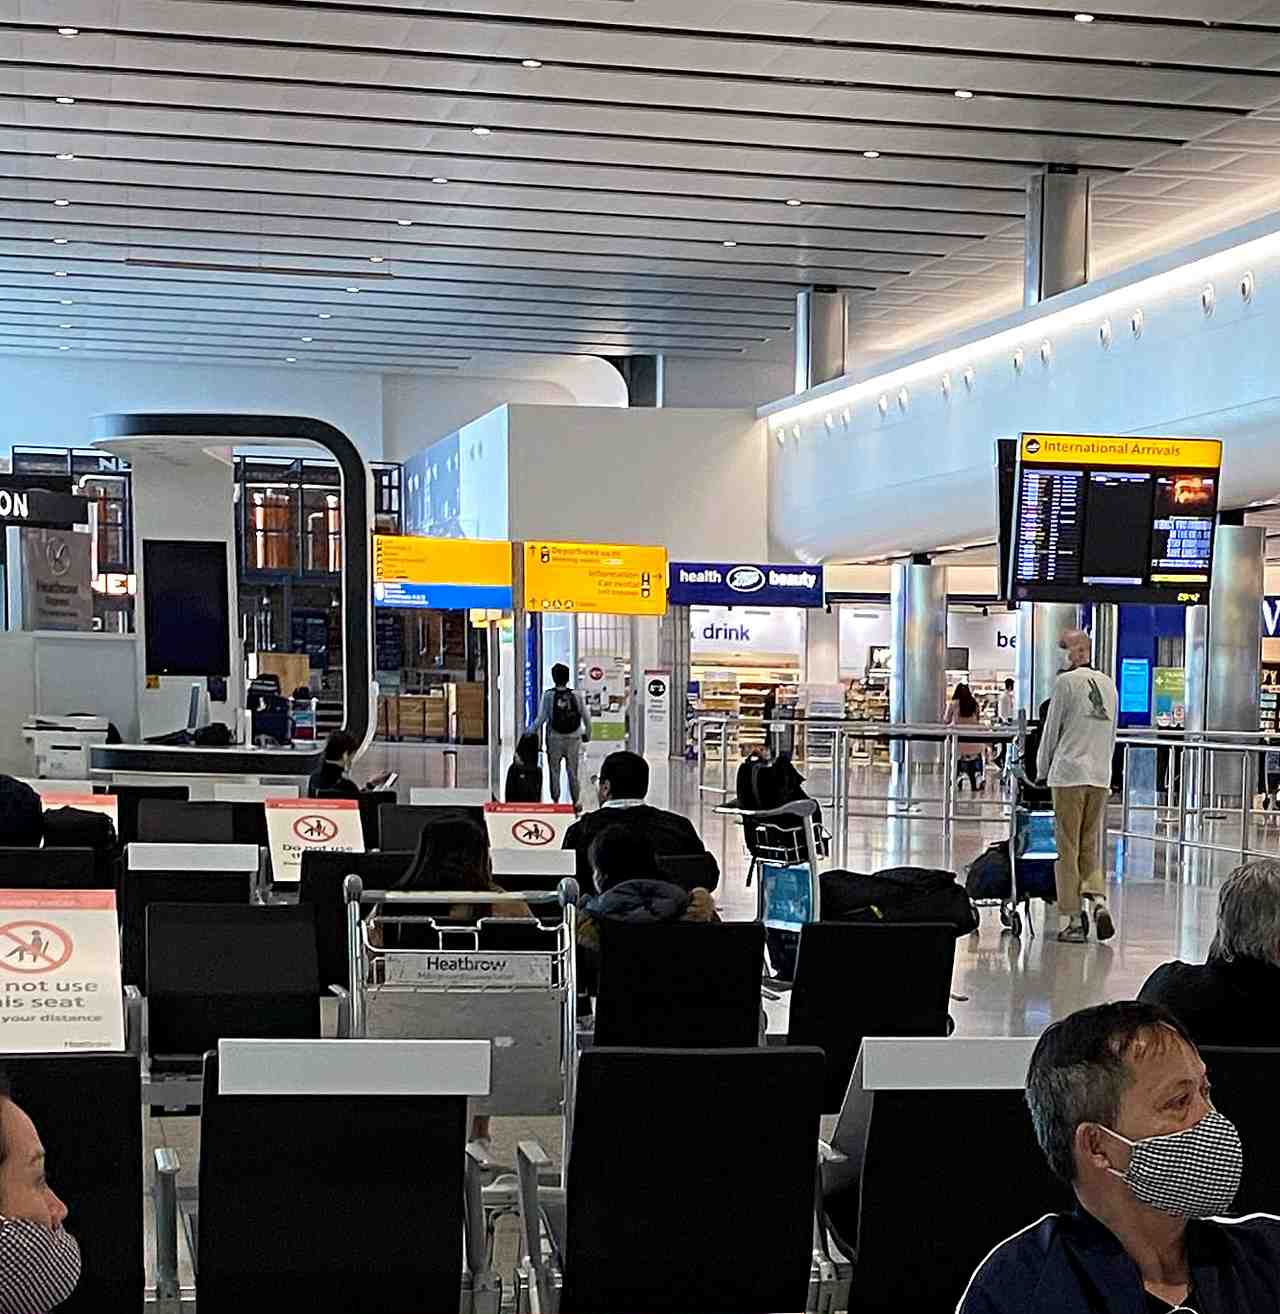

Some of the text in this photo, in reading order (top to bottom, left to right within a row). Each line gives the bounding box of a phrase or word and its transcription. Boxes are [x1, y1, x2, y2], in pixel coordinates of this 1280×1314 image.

[1044, 440, 1180, 456] International Arrivals
[679, 569, 722, 583] health
[769, 570, 816, 589] beauty
[703, 623, 751, 640] drink
[427, 956, 506, 972] Heathrow
[6, 979, 49, 993] not
[56, 981, 98, 993] use
[32, 996, 86, 1009] seat
[1, 1015, 36, 1024] your
[40, 1013, 103, 1023] distance
